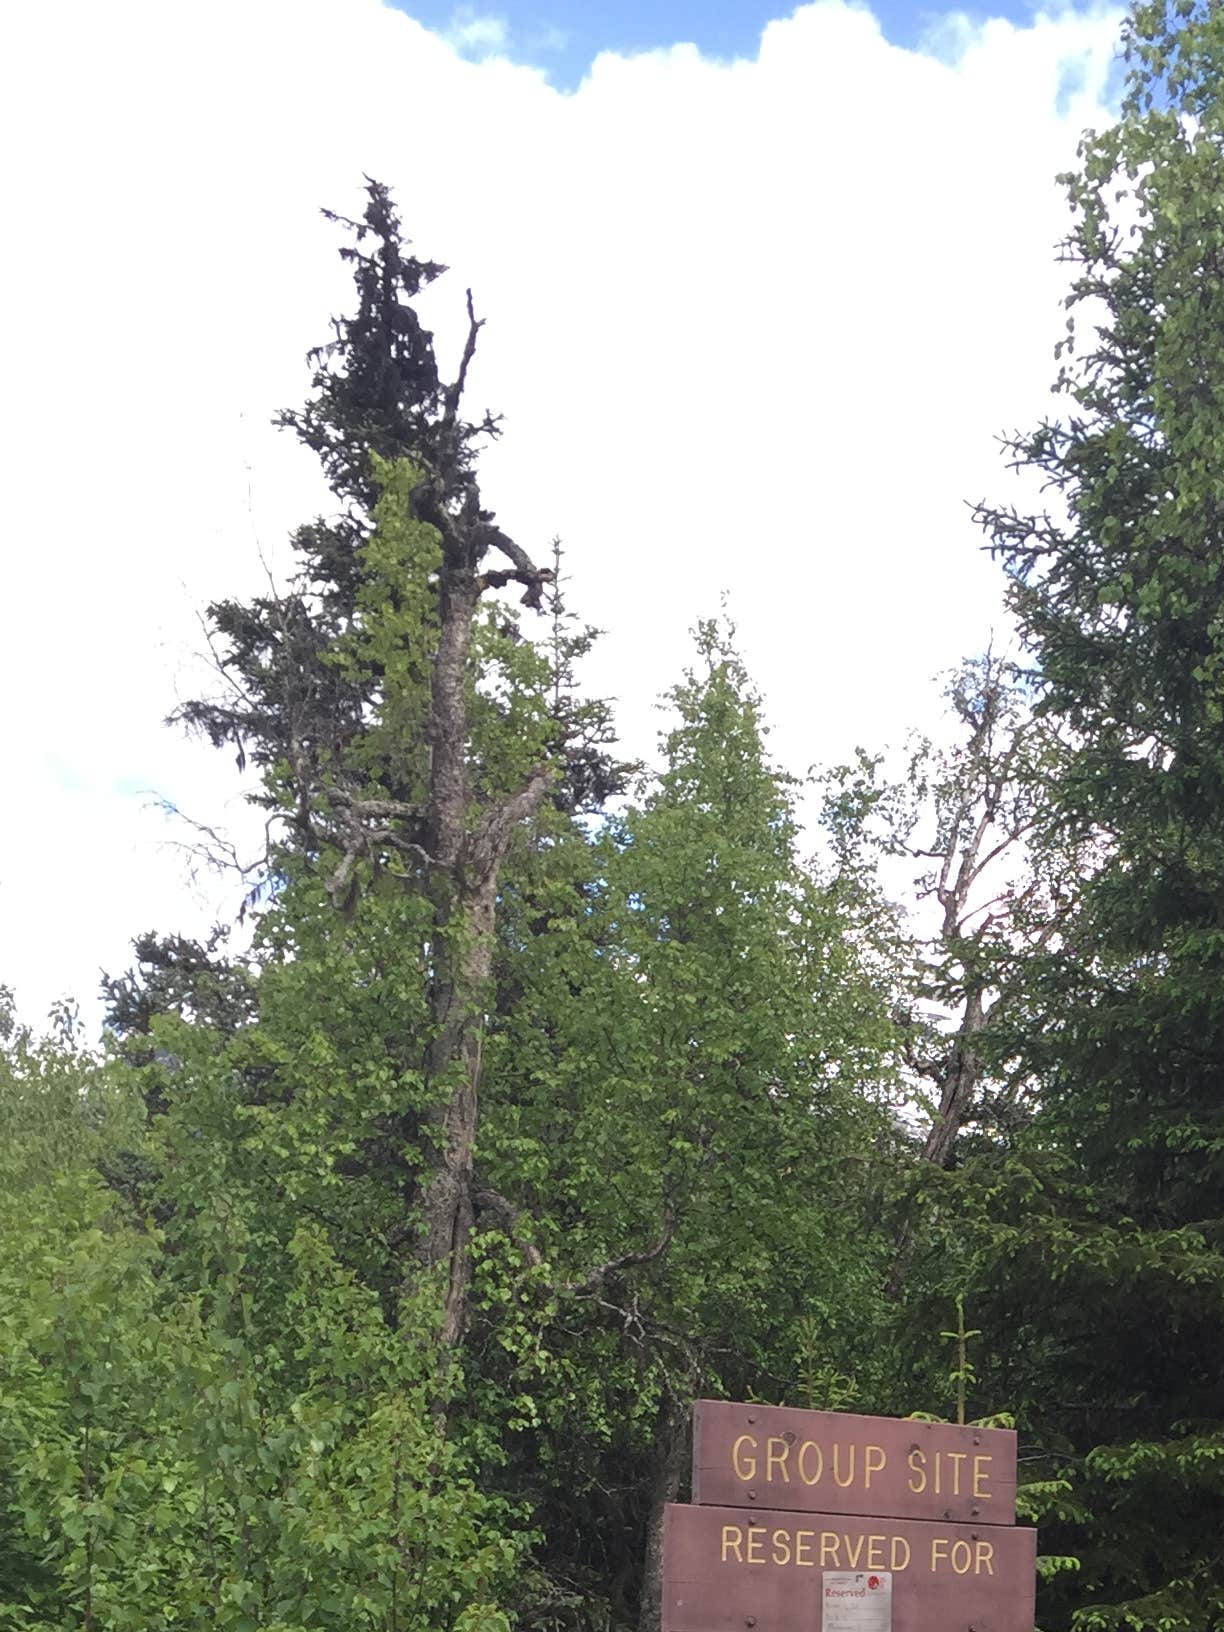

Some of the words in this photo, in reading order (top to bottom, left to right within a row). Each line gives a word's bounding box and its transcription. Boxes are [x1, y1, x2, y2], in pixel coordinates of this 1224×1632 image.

[731, 1434, 887, 1489] GROUP
[907, 1449, 994, 1498] SITE
[721, 1525, 912, 1572] RESERVED
[930, 1538, 995, 1576] FOR
[825, 1588, 867, 1598] Reserved
